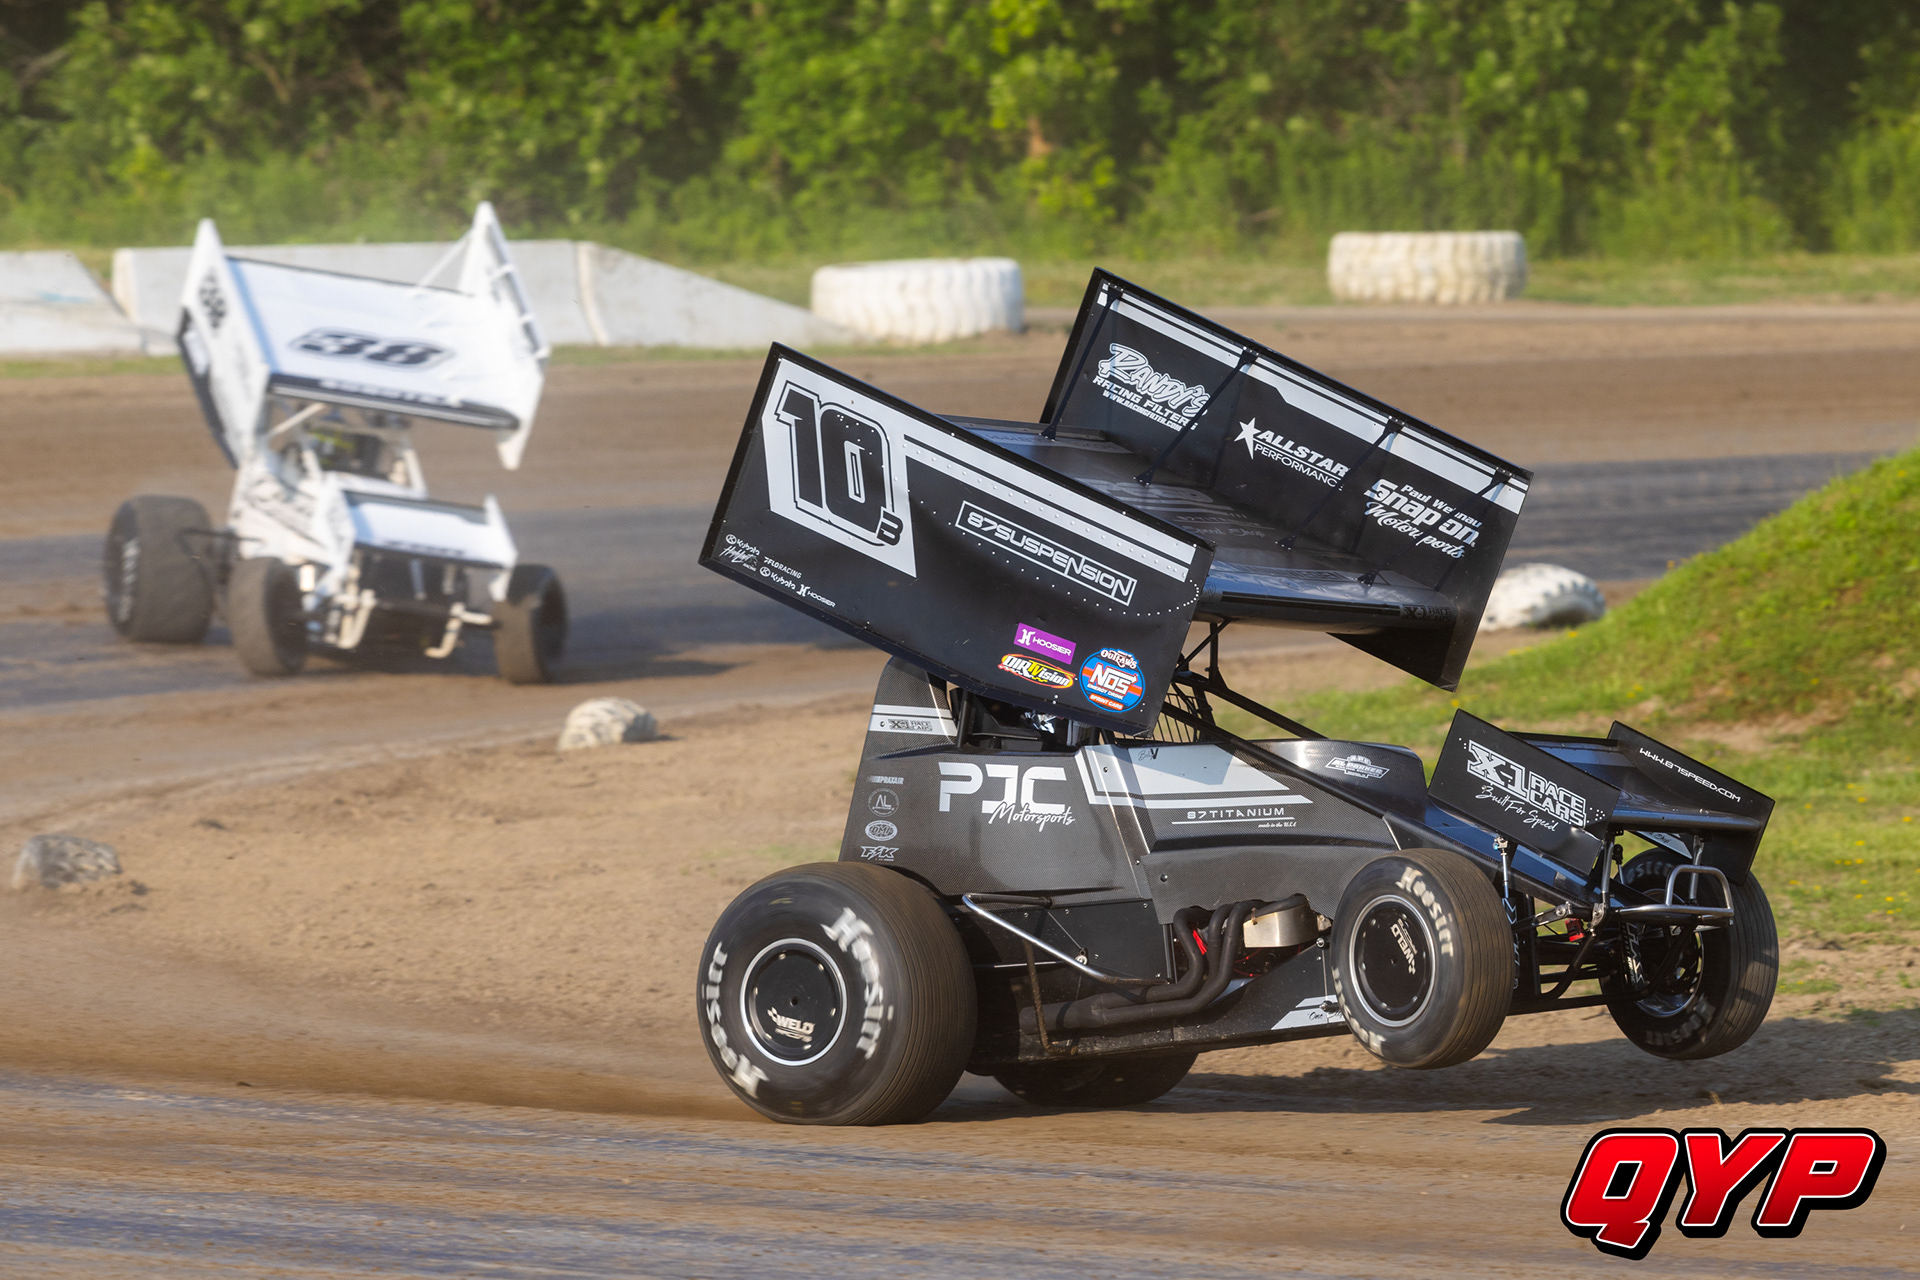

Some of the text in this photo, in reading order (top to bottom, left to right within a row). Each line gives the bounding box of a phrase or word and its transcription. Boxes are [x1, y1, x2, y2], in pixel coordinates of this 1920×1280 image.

[1092, 375, 1143, 404] RACING
[1098, 343, 1211, 418] RANDY'S
[1256, 430, 1351, 477] ALLSTAR
[1400, 484, 1432, 503] Paul
[967, 513, 1136, 605] 87SUSPENSION
[771, 571, 796, 590] Kubota
[1033, 636, 1072, 656] HOOSIER
[1089, 663, 1139, 695] NOS
[939, 762, 1068, 815] PJC
[1467, 740, 1529, 801] X-1
[1475, 785, 1559, 832] Built For Speed
[1528, 790, 1587, 829] CARS
[1529, 771, 1586, 814] RACE
[989, 803, 1076, 833] Motorsports
[1390, 923, 1414, 965] WELD
[777, 1014, 816, 1035] WELD
